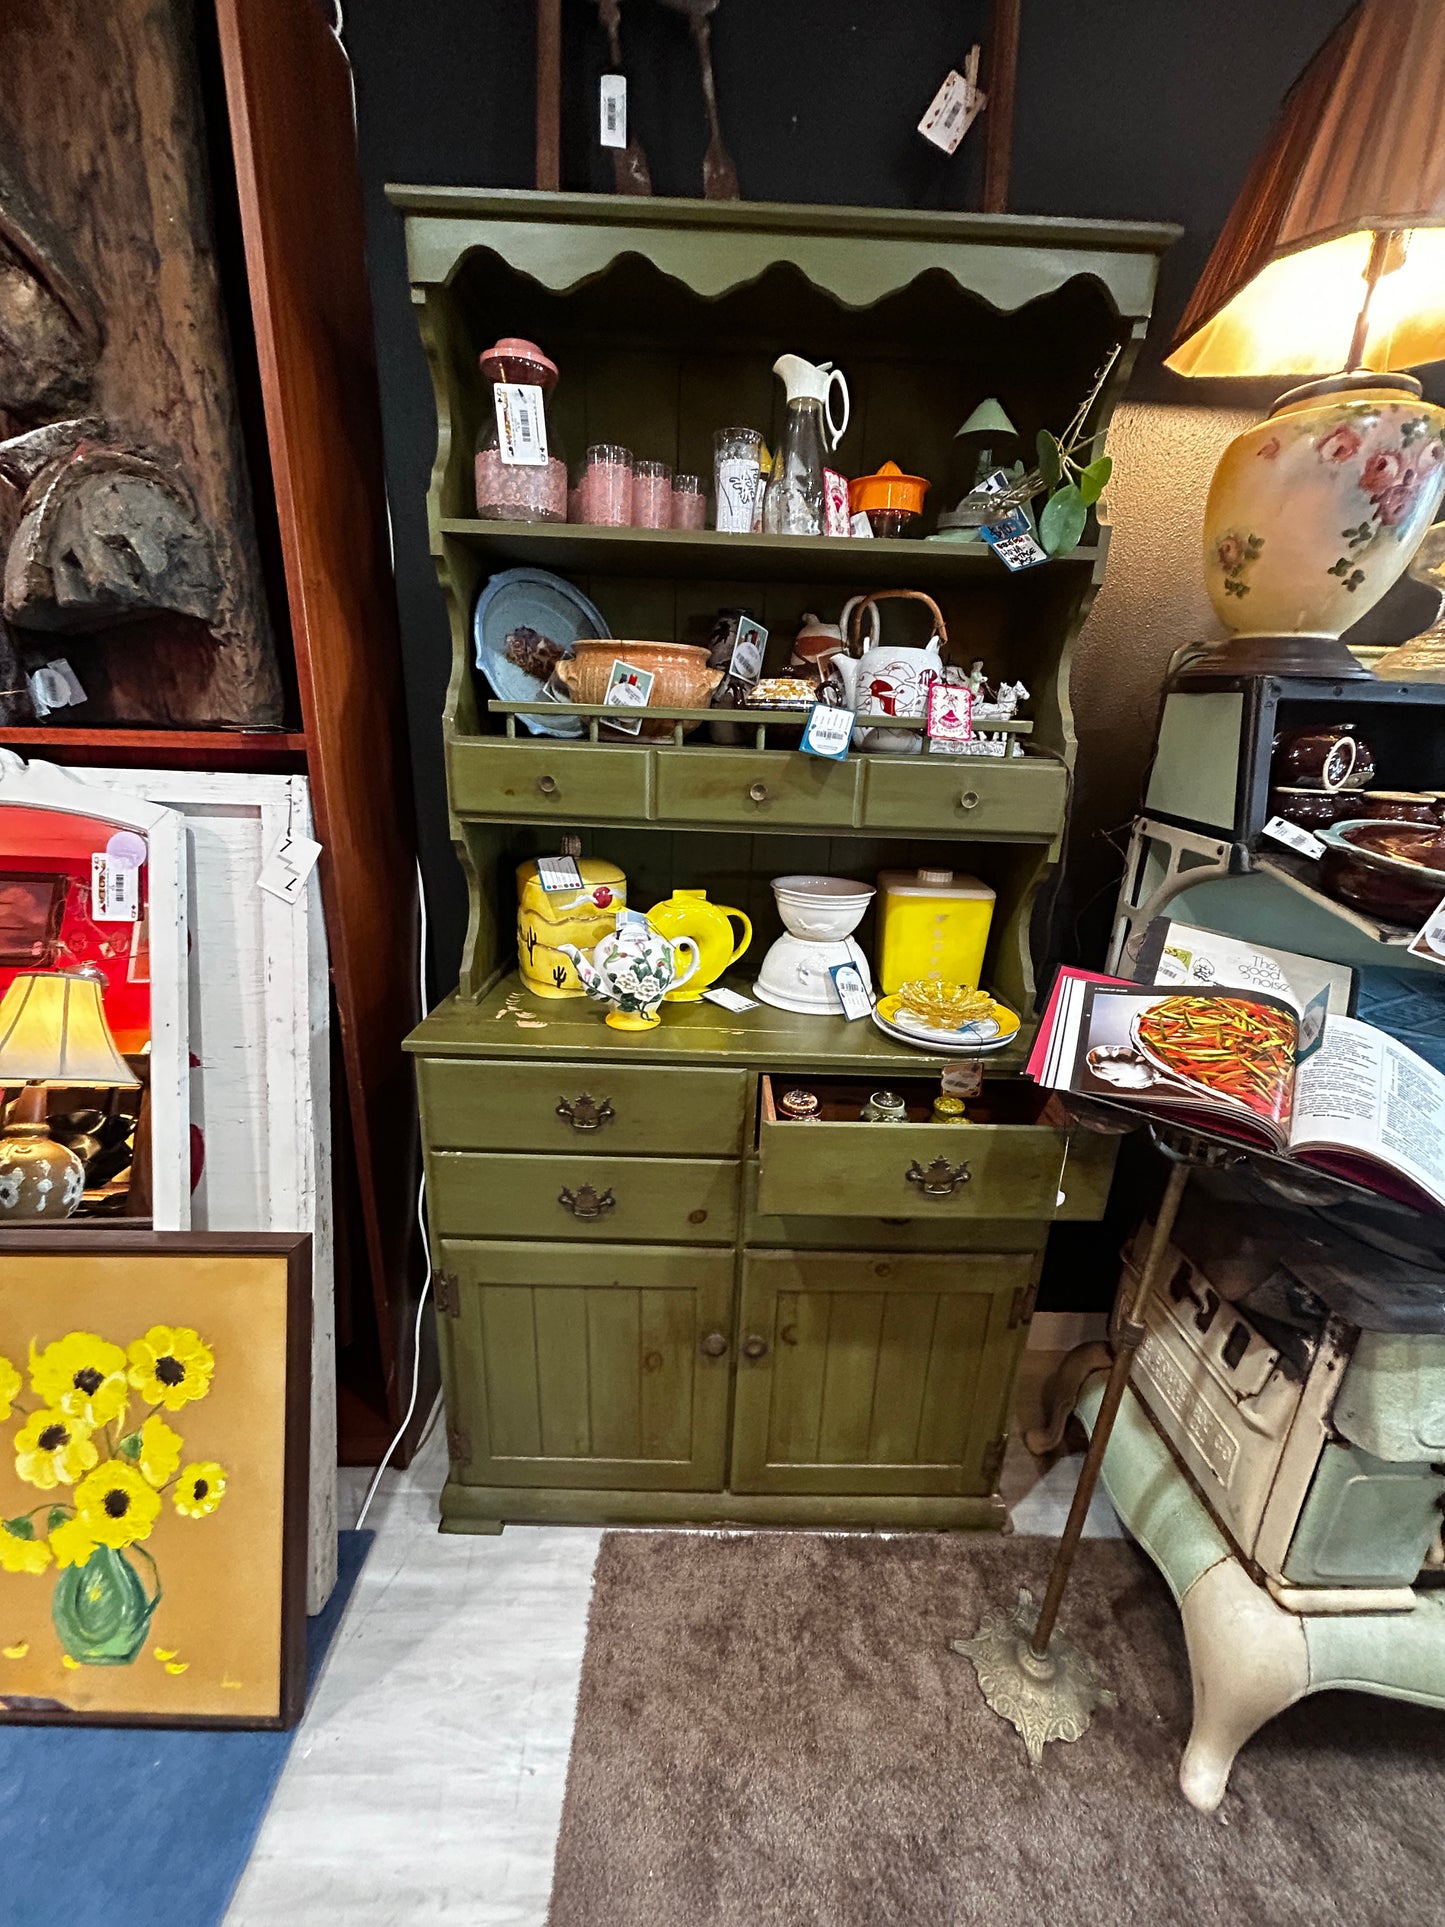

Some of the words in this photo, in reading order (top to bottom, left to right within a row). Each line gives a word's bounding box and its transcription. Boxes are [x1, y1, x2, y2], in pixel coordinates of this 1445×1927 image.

[1253, 955, 1278, 971] The
[1238, 964, 1281, 979] good
[1252, 977, 1290, 993] noise
